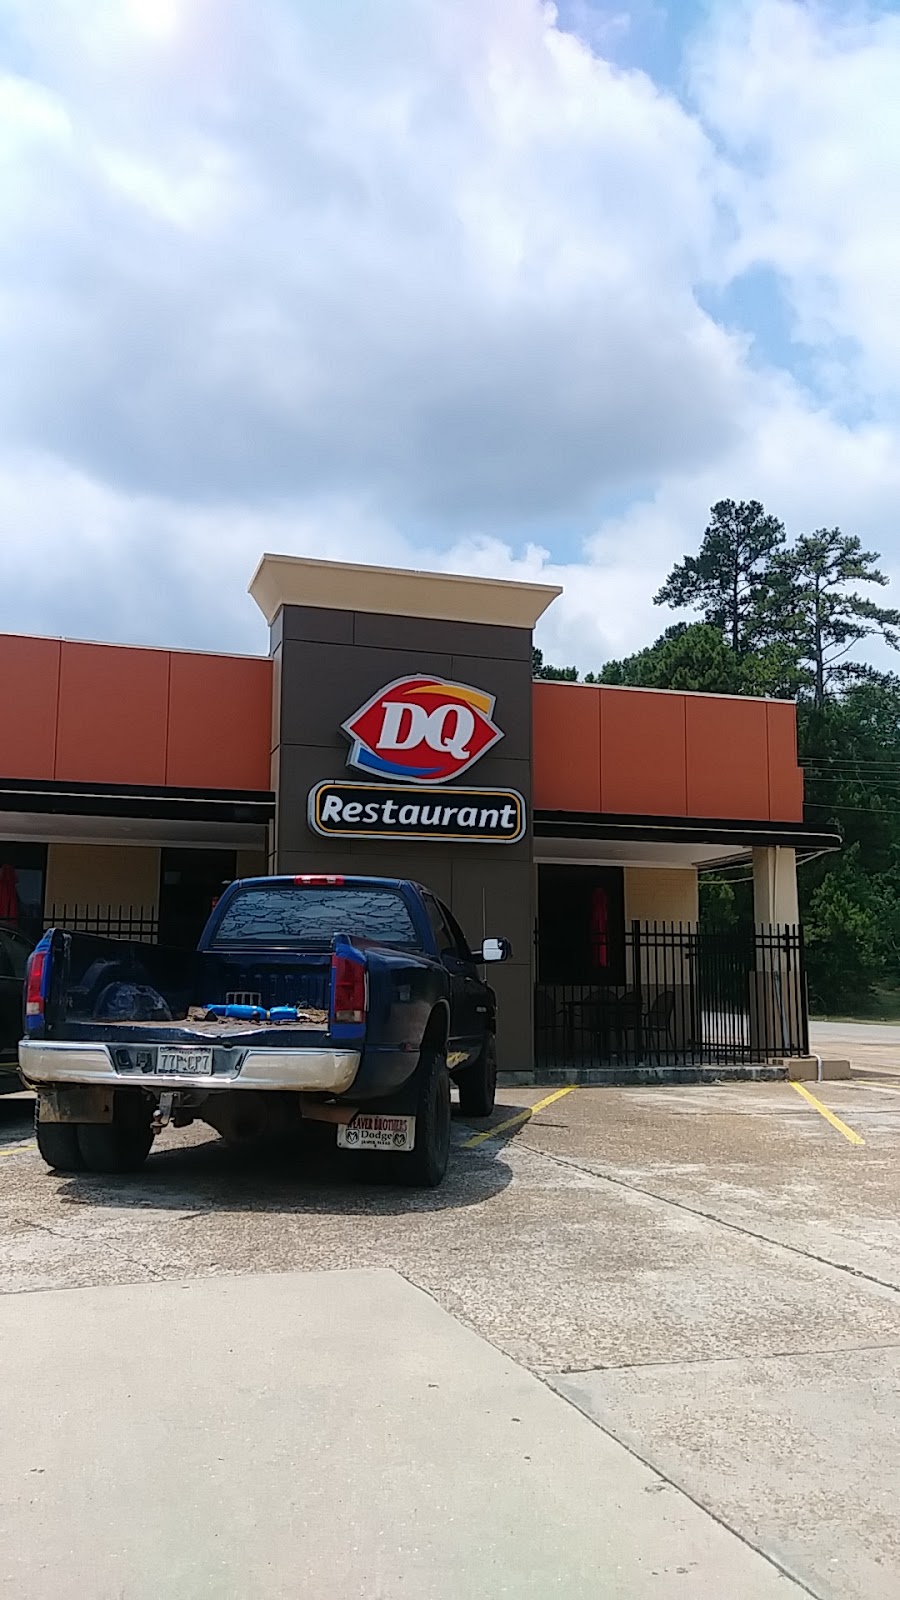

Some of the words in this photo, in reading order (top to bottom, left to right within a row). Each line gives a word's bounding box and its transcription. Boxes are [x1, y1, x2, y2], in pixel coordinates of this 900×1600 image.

[376, 701, 475, 760] DQ
[321, 795, 516, 827] Restaurant
[361, 1130, 392, 1142] Dodge
[374, 1118, 407, 1132] BROTHERS
